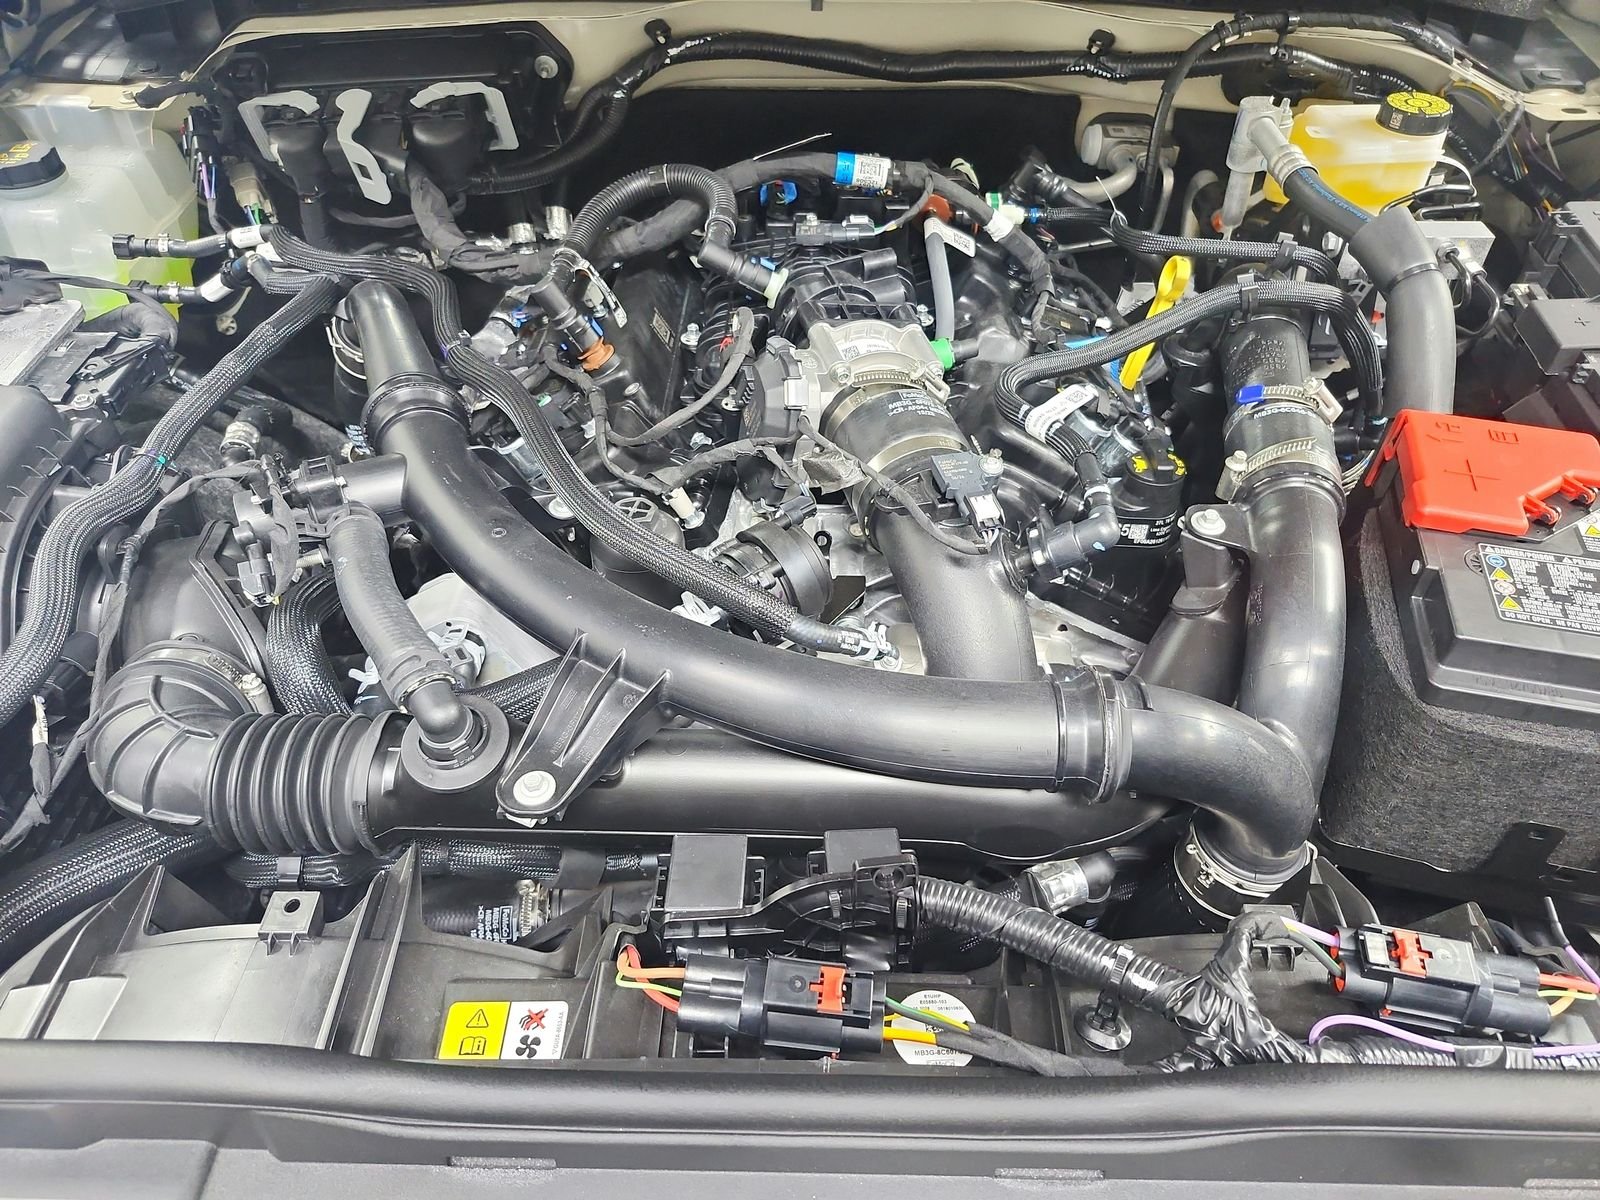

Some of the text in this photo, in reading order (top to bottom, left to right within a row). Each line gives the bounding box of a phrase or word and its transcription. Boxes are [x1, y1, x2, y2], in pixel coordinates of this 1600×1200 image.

[1494, 547, 1555, 562] DANGER/POISON
[1504, 611, 1516, 619] DO
[1516, 613, 1531, 621] NOT
[1566, 621, 1581, 629] PAS
[502, 909, 510, 938] FoMoCo
